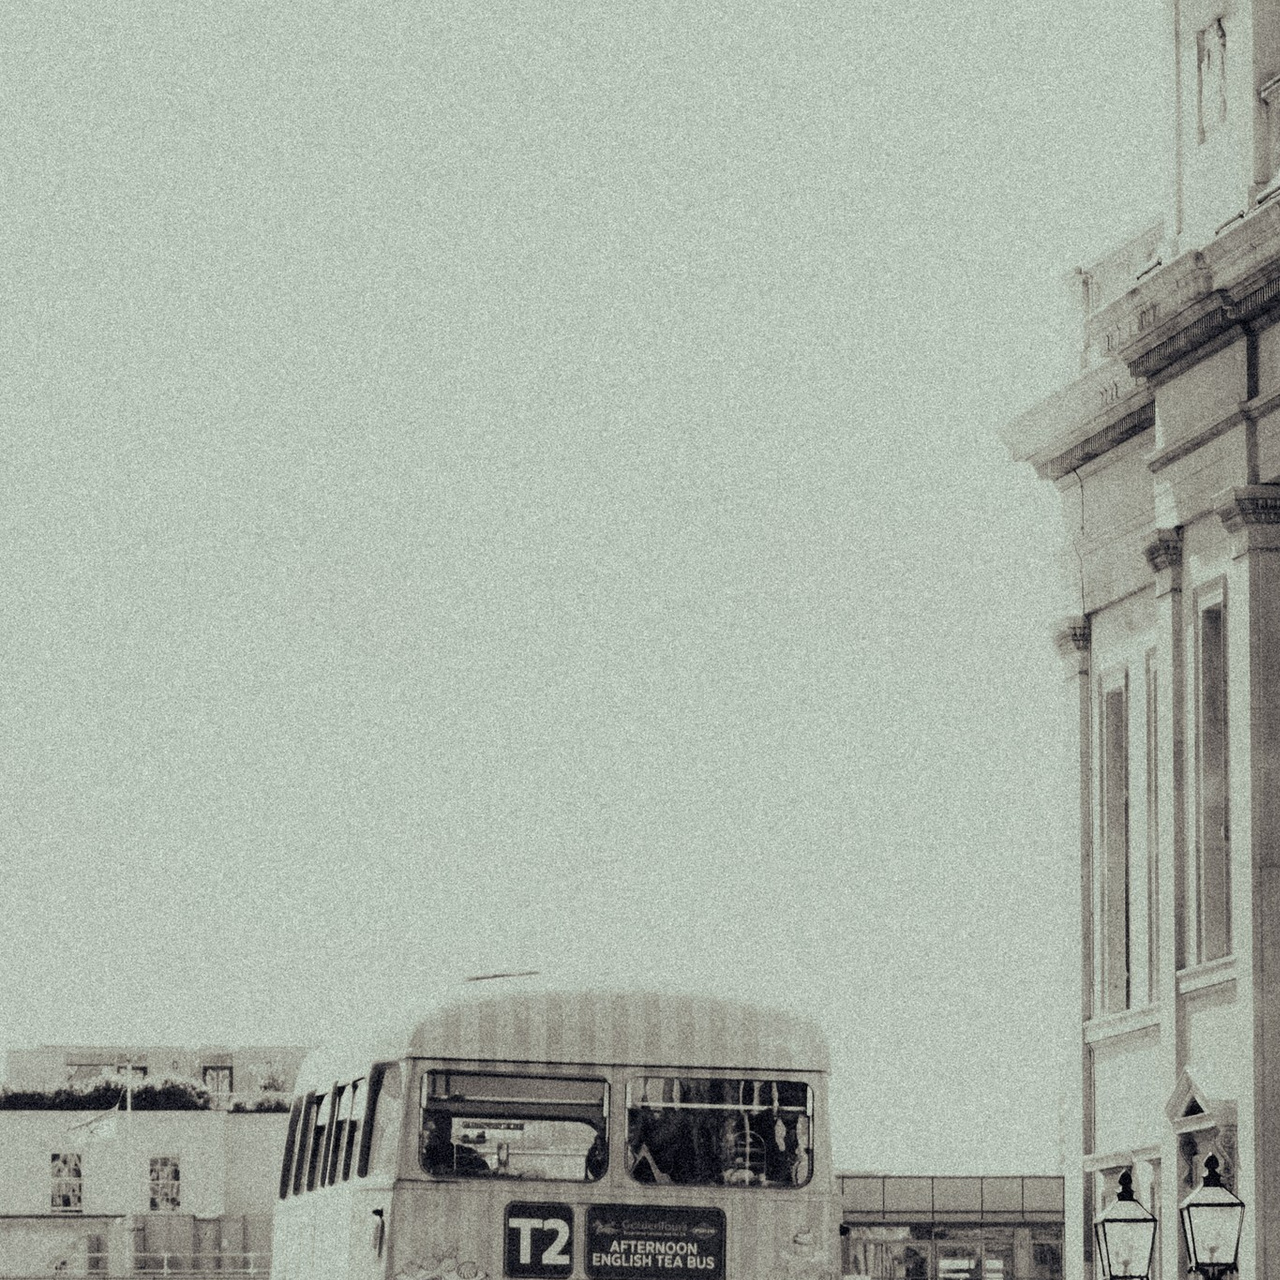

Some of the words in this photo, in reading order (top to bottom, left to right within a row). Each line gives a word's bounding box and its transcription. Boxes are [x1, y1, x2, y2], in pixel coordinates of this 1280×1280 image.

[509, 1218, 570, 1265] T2
[610, 1240, 698, 1255] AFTERNOON
[592, 1253, 652, 1267] ENGLISH
[656, 1255, 683, 1268] TEA
[687, 1256, 715, 1269] BUS
